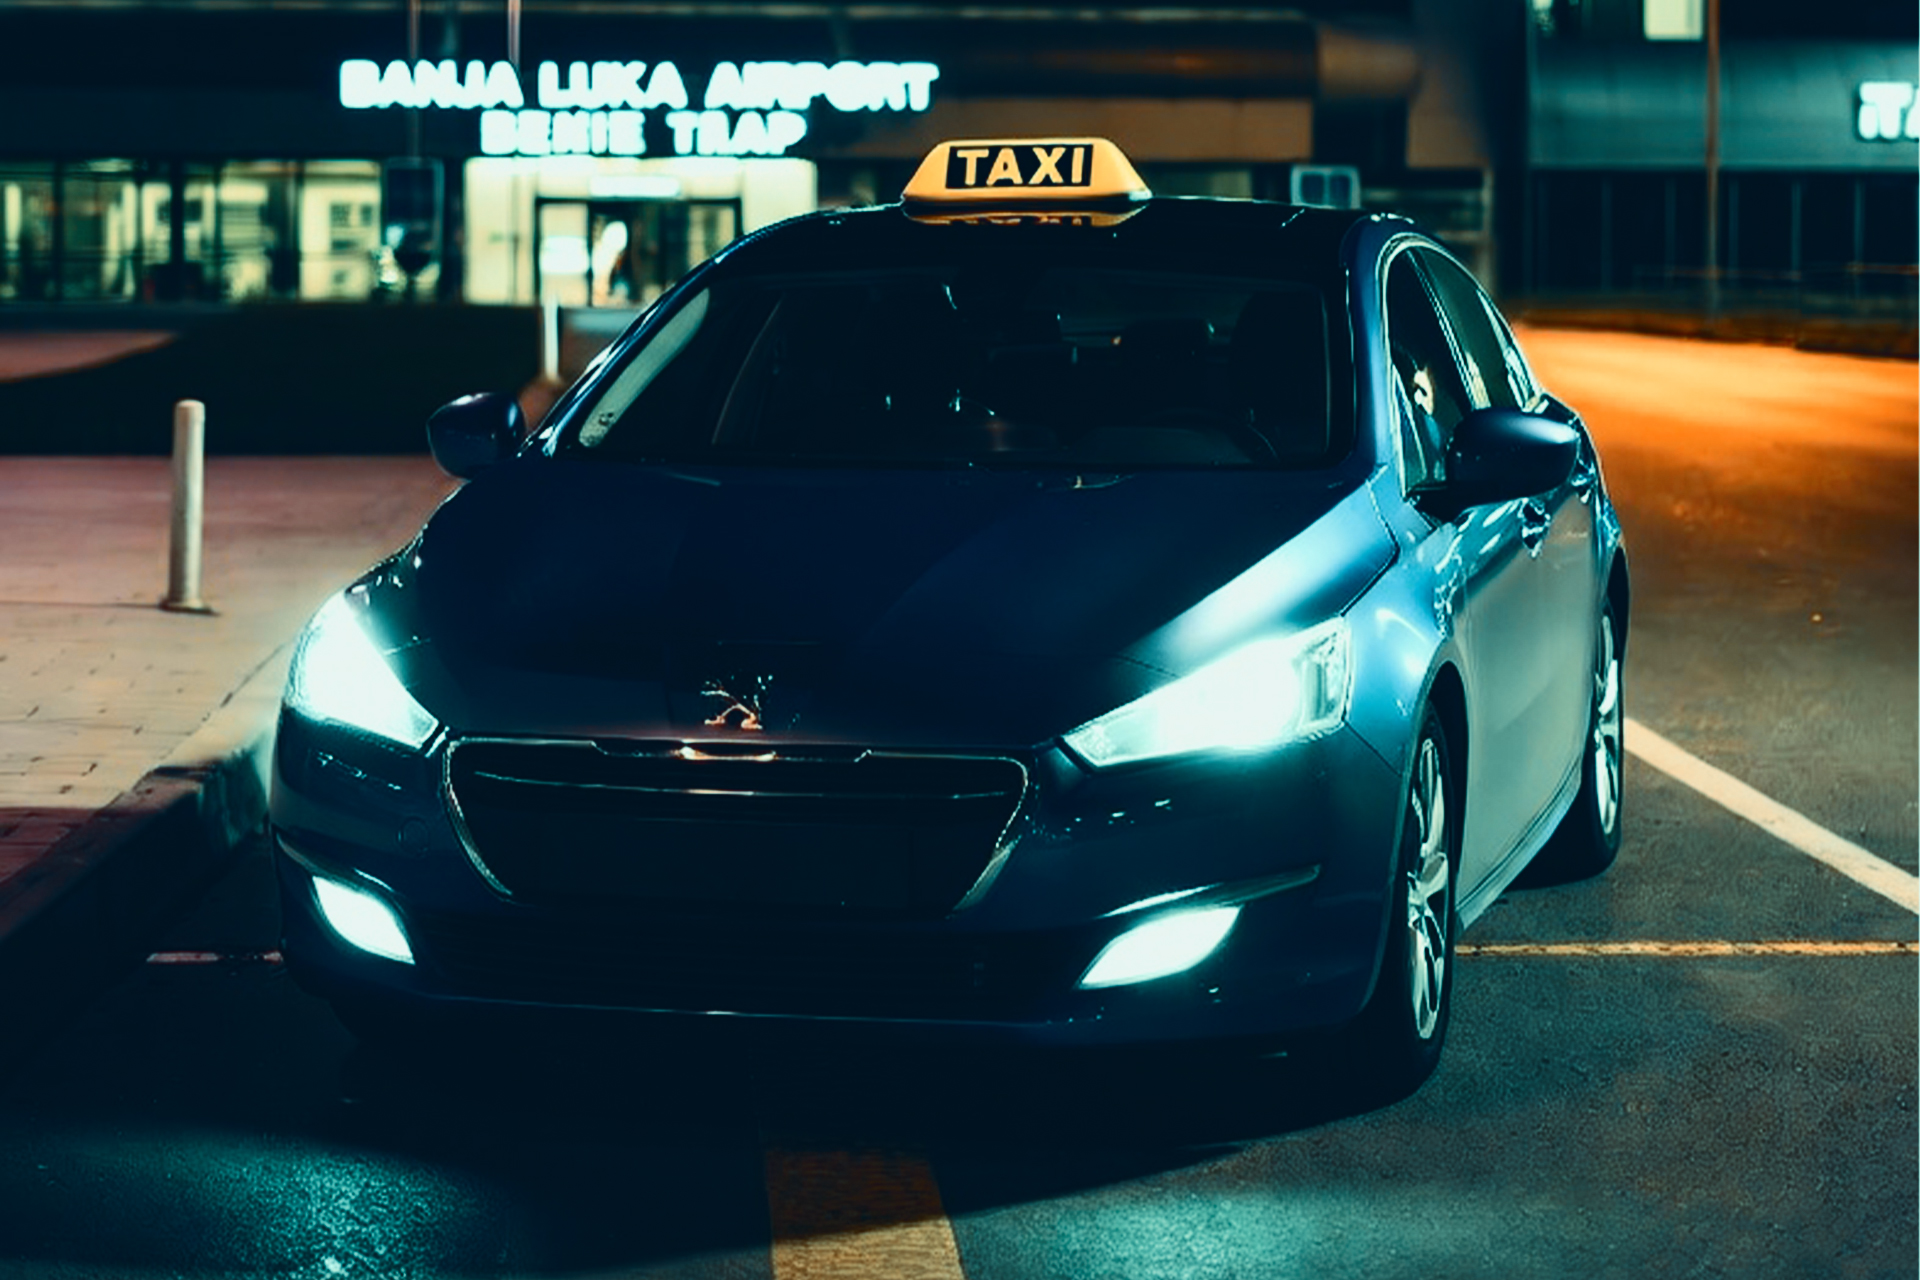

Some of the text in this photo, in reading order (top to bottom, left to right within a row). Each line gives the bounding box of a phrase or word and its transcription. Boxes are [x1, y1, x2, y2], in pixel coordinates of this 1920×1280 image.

[340, 59, 940, 112] BANJA LUKA AIRPORT
[956, 146, 1085, 186] TAXI
